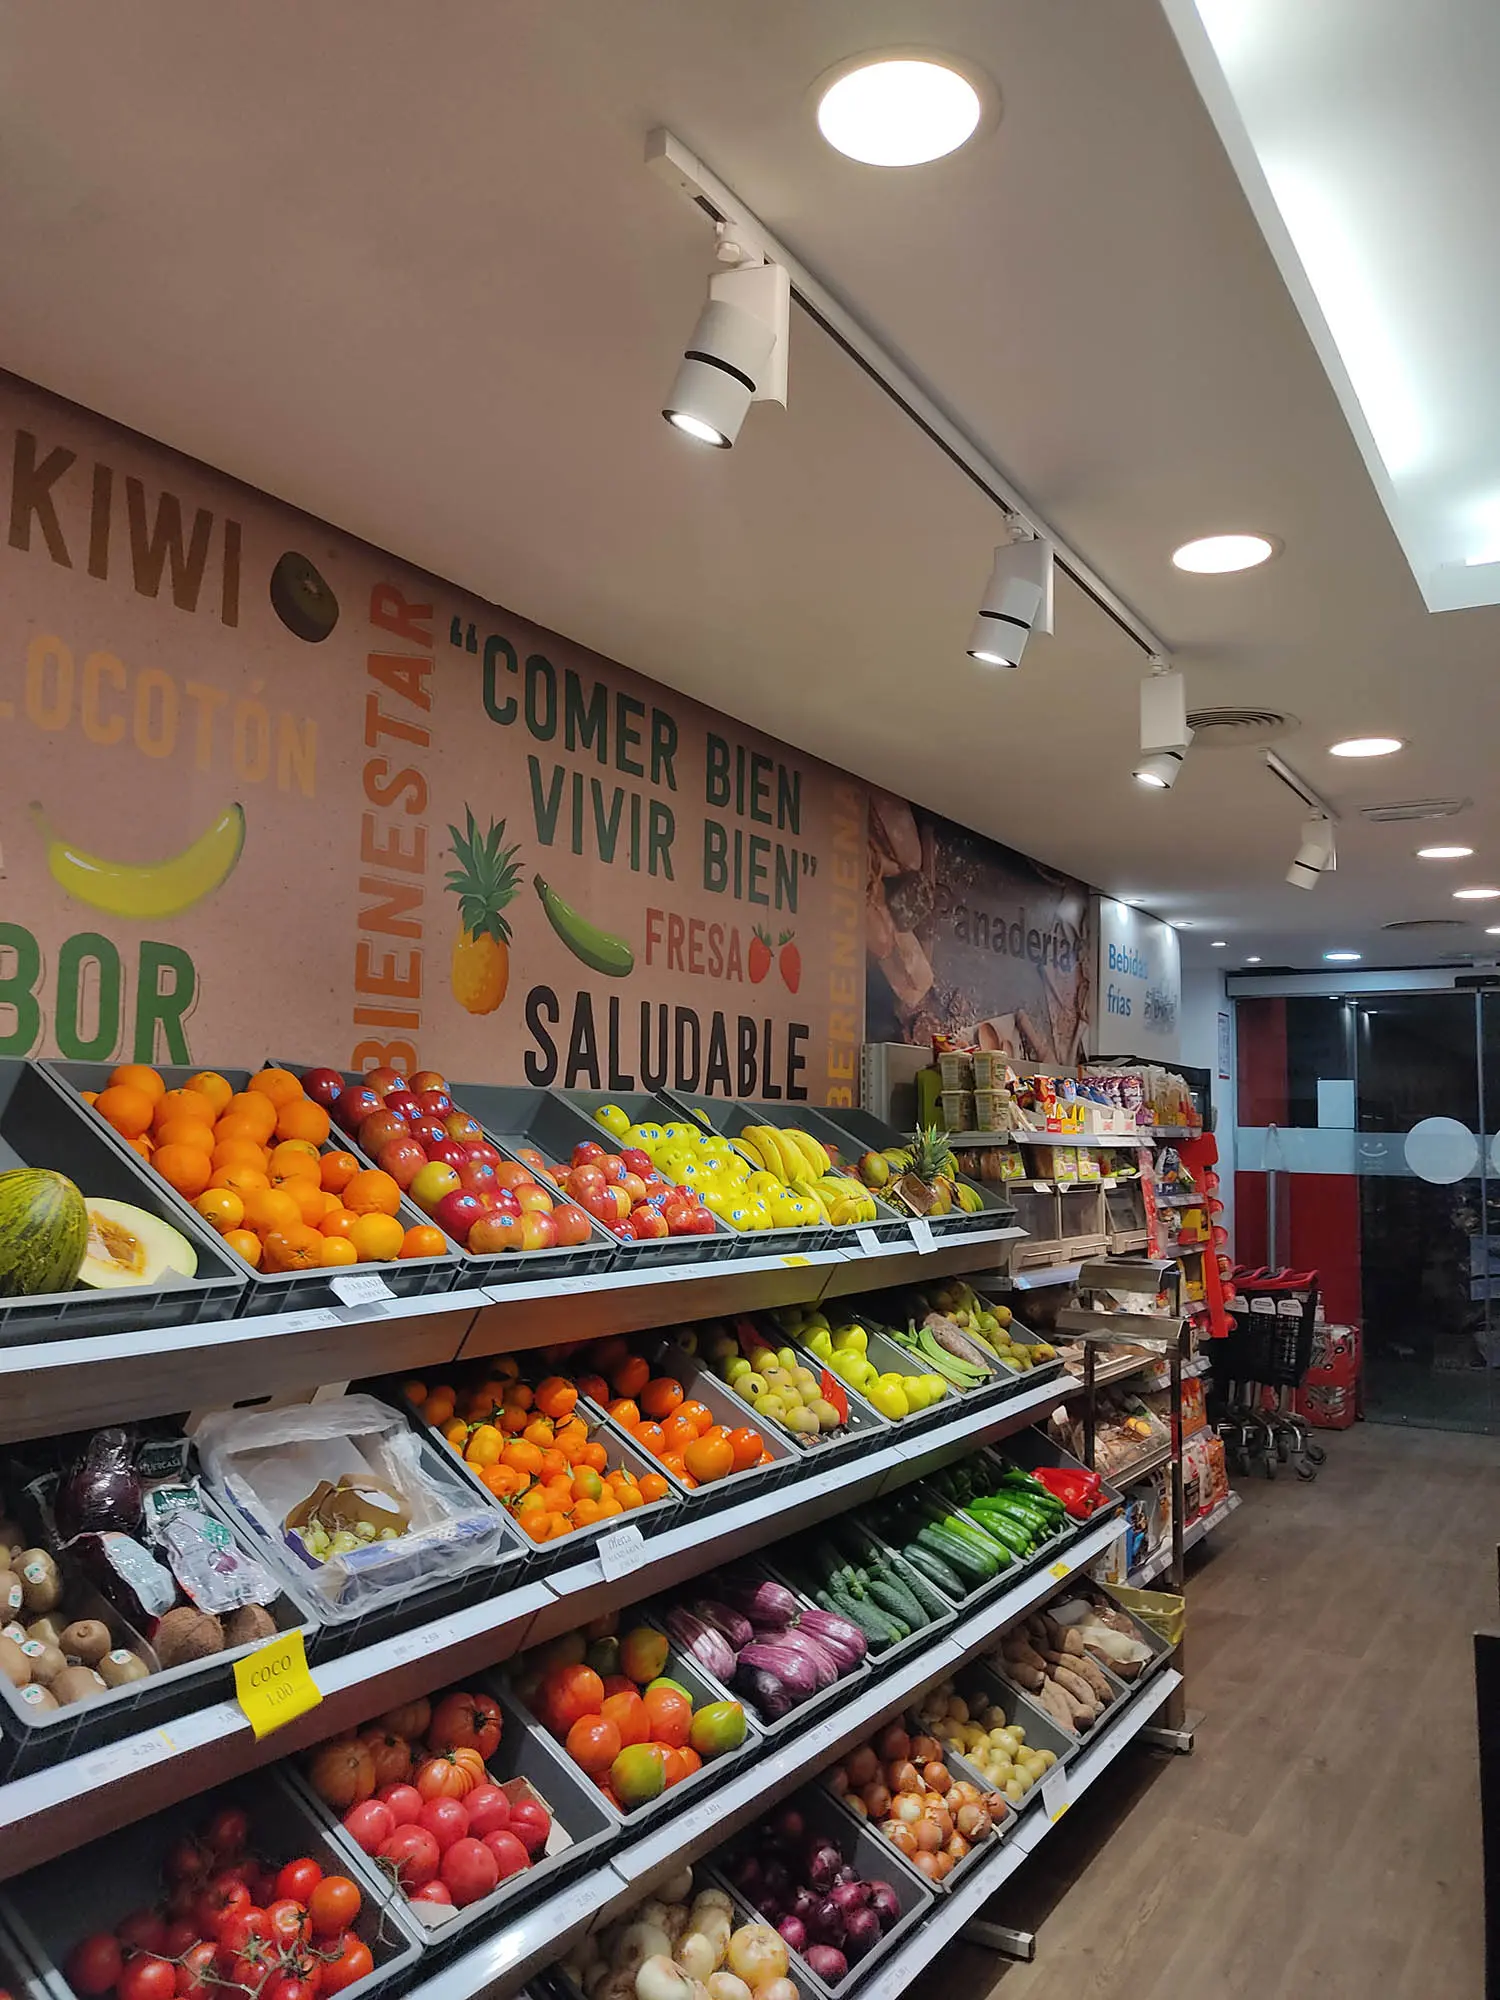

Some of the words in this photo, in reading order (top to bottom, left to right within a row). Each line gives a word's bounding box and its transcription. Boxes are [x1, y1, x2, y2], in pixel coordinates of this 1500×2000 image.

[8, 429, 242, 628] KIWI
[350, 580, 437, 1076] BIENESTAR
[527, 755, 676, 881] VIVIR
[706, 732, 804, 836] BIEN
[645, 907, 744, 982] FRESA
[523, 984, 810, 1100] SALUDABLE
[250, 1654, 292, 1688] COCO
